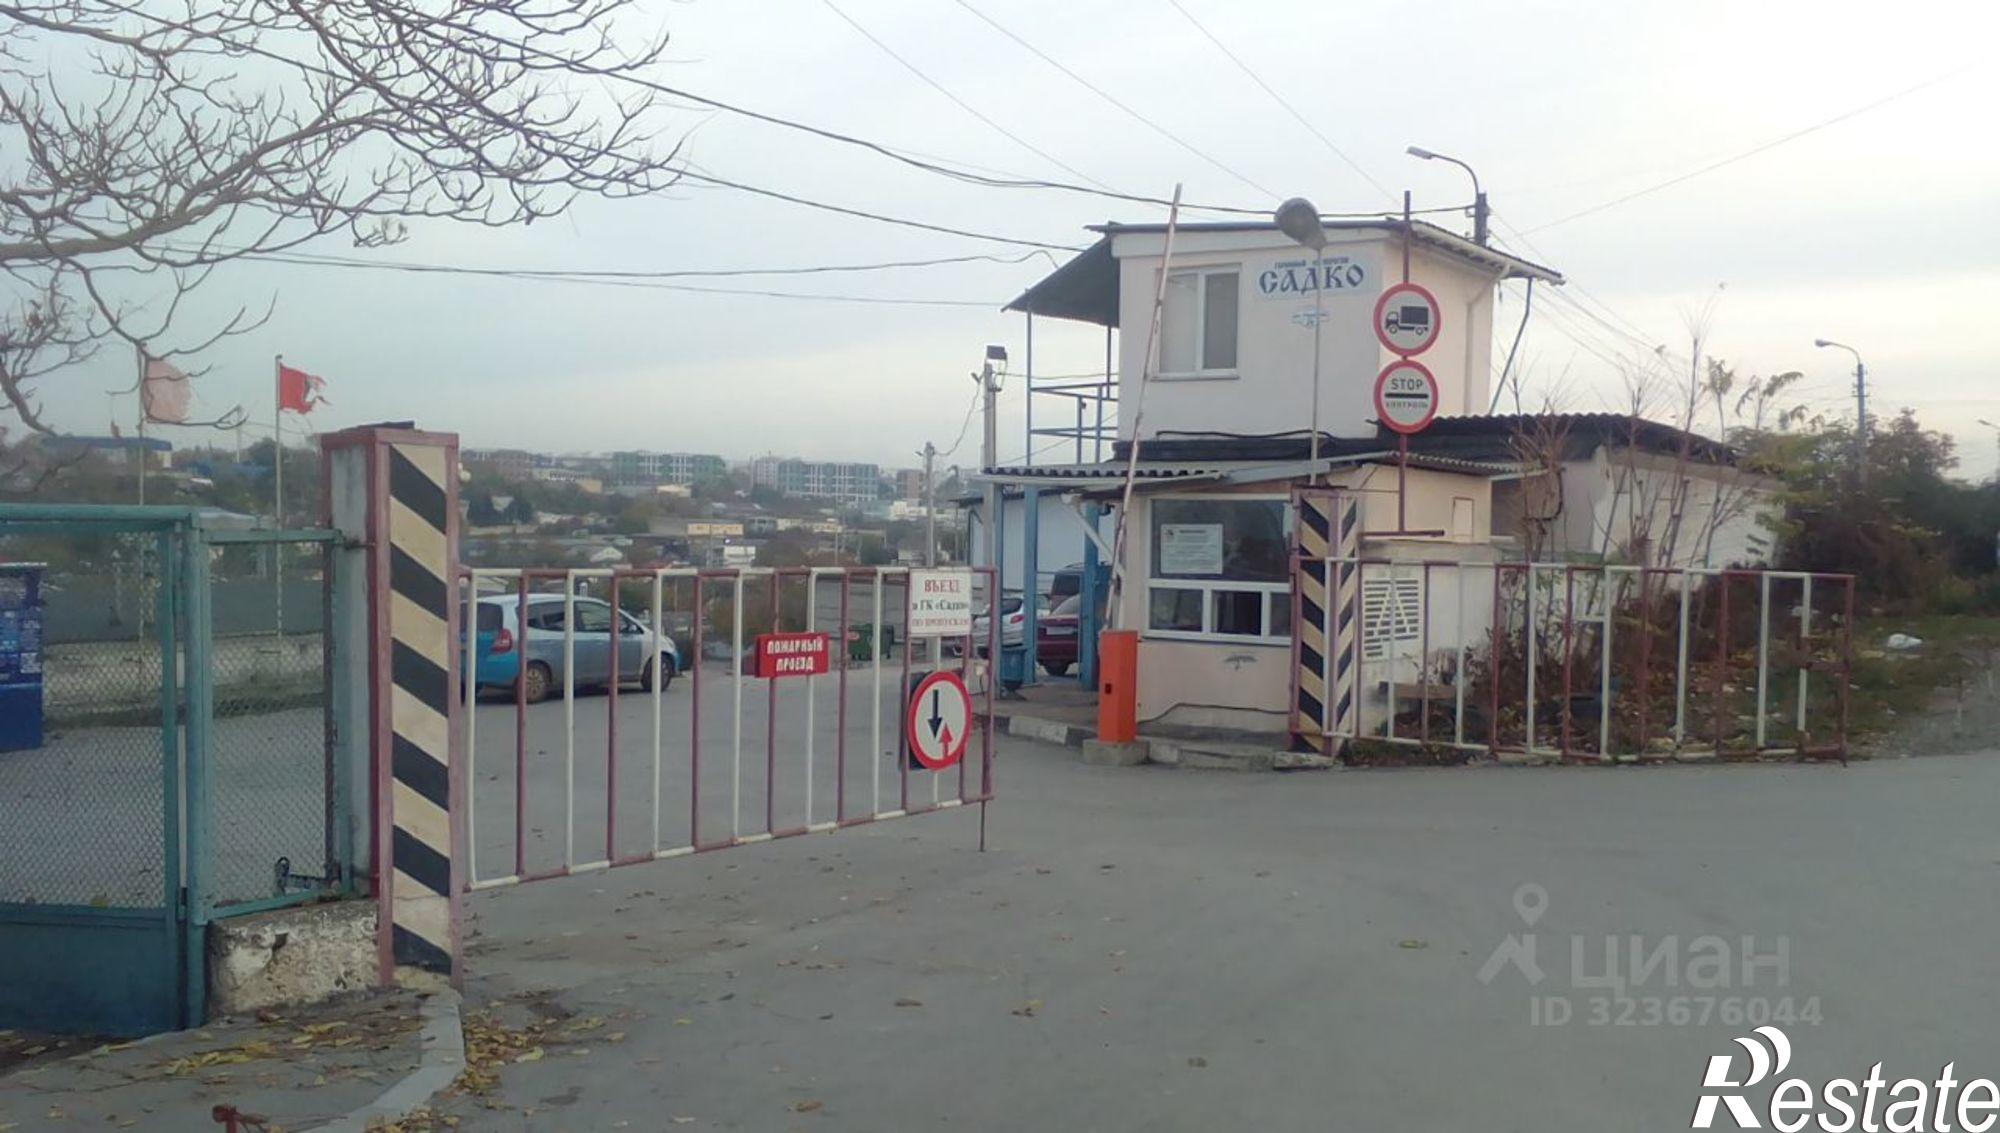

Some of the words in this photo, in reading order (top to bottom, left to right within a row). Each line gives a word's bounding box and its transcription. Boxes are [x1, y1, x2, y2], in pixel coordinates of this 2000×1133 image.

[1259, 264, 1364, 294] САДКО
[1391, 378, 1423, 390] STOP
[766, 636, 823, 654] ПОЖАРНЫЙ
[776, 656, 814, 672] ПРОЕЗД
